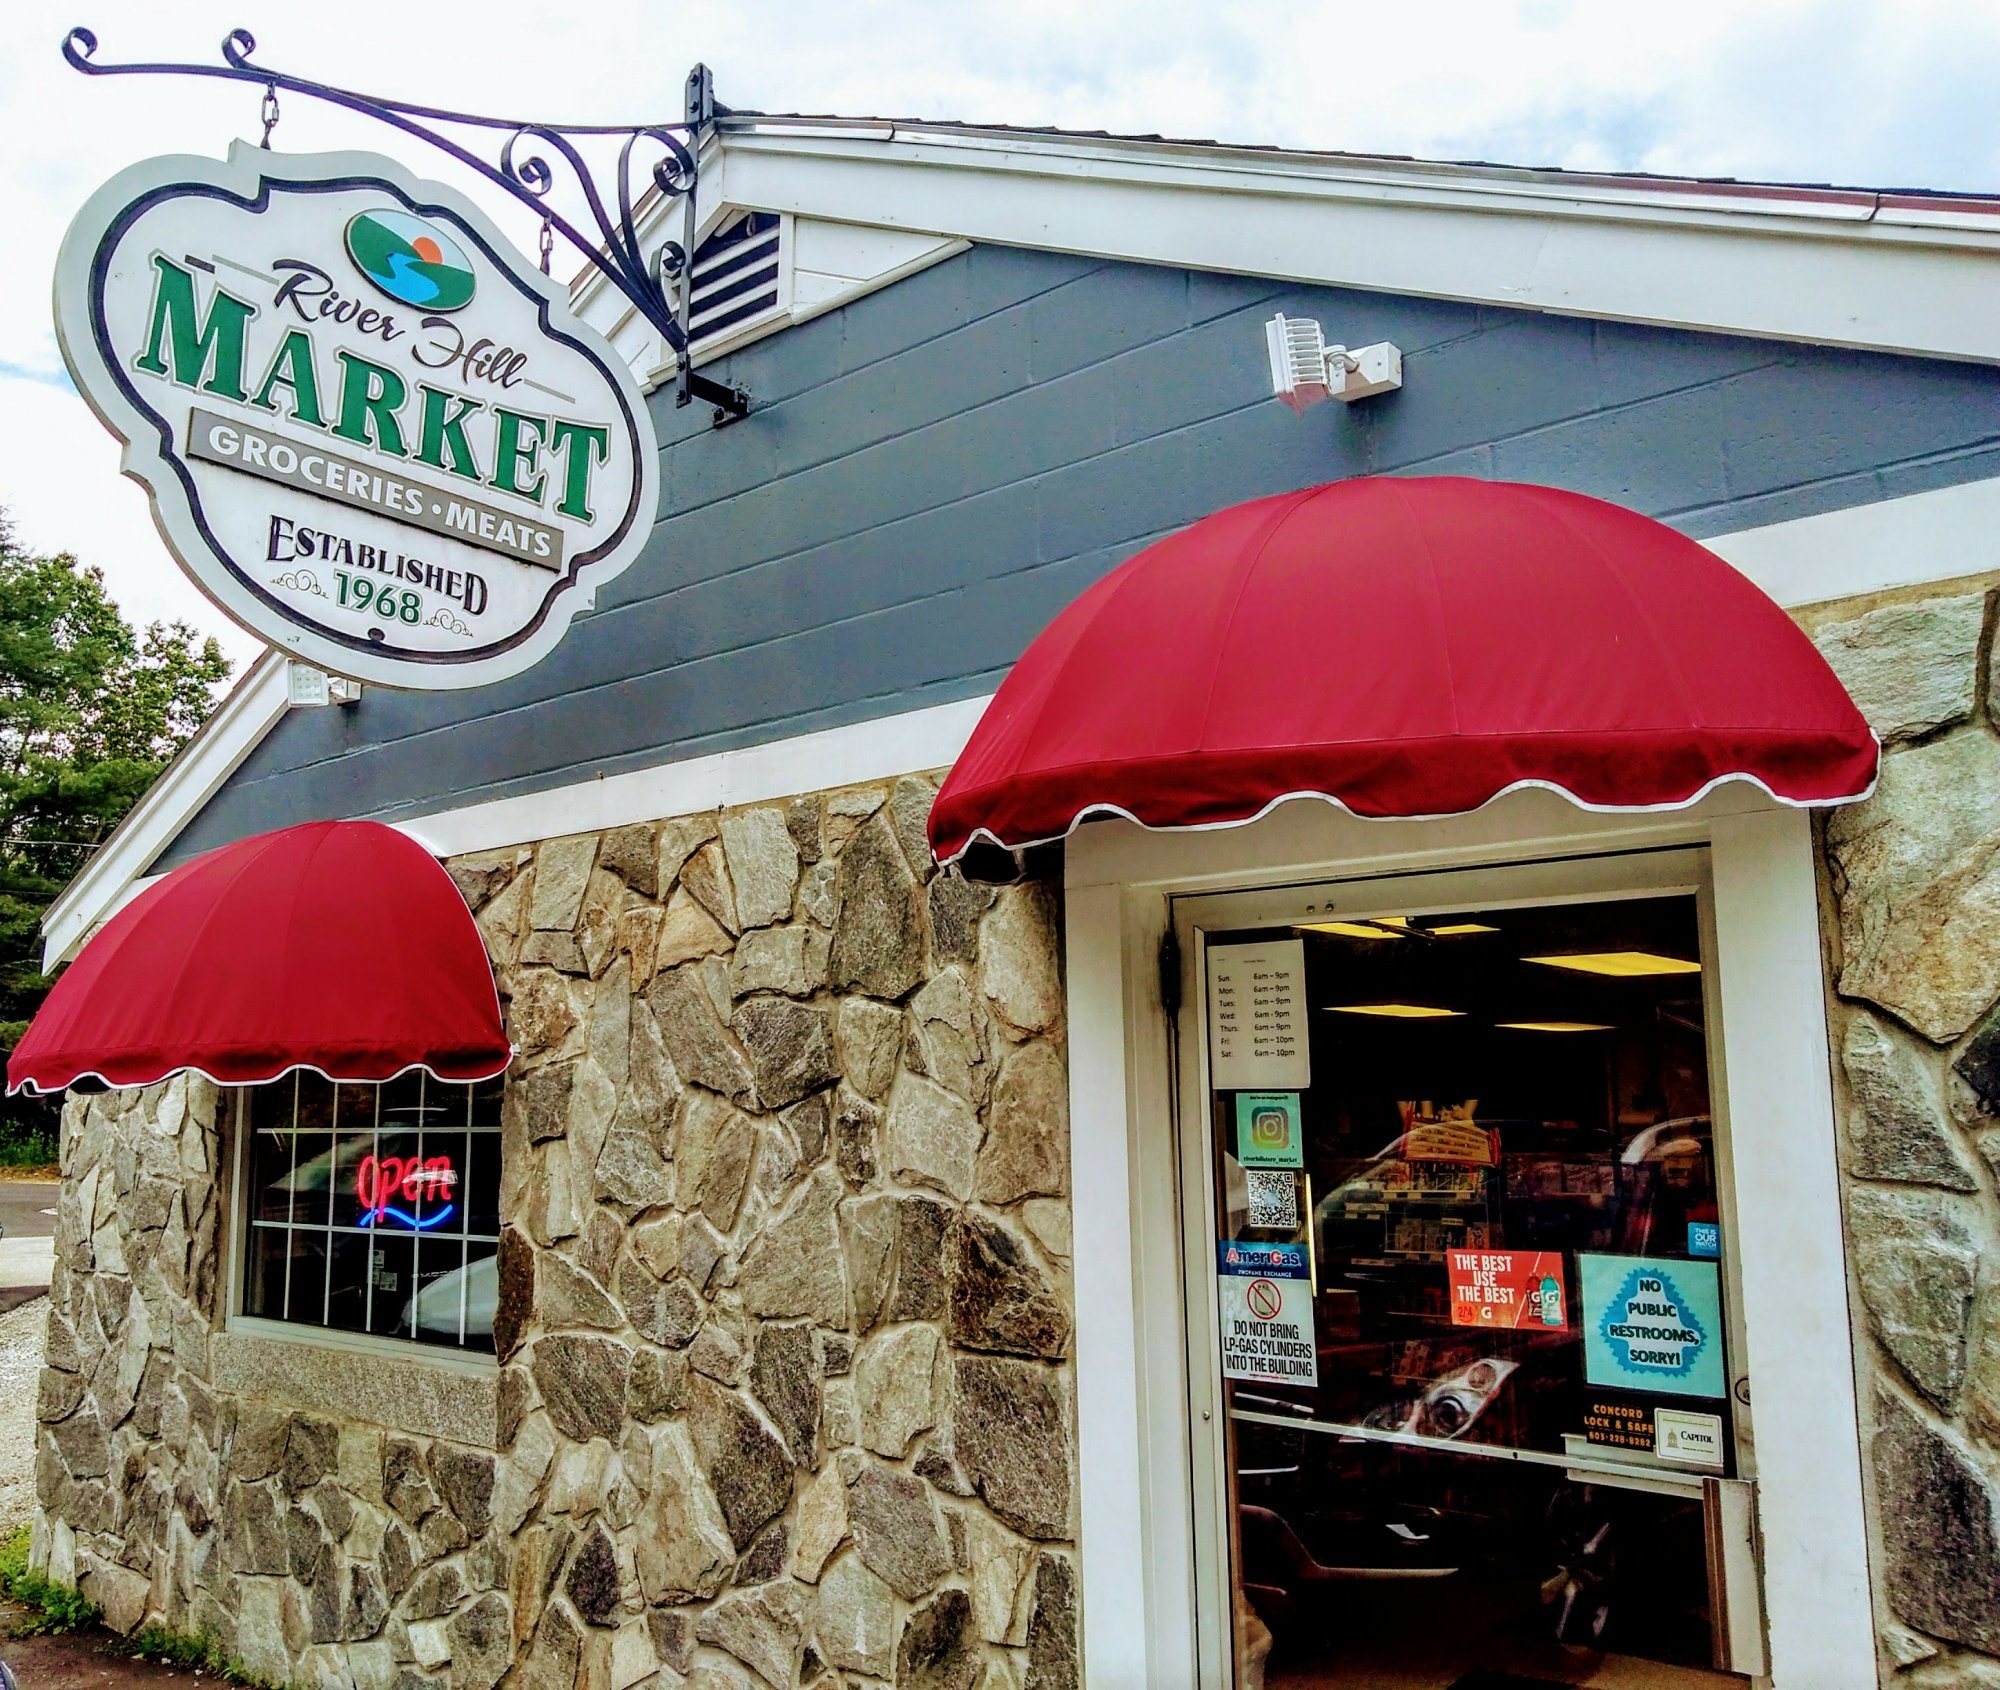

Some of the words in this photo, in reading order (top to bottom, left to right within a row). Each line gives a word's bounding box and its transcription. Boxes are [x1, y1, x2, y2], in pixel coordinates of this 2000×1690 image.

[272, 258, 404, 341] River
[412, 317, 528, 389] Hill
[134, 251, 610, 525] MARKET
[208, 426, 424, 515] GROCERIES
[445, 509, 552, 557] MEATS
[266, 515, 488, 616] ESTABLISHED
[335, 570, 424, 627] 1968
[1254, 972, 1268, 980] 6am
[1275, 971, 1289, 979] 9pm
[1275, 984, 1290, 992] 9pm
[1254, 998, 1268, 1006] 6am
[1275, 997, 1291, 1005] 9pm
[1274, 1010, 1290, 1018] 9pm
[1254, 1023, 1269, 1031] 6am
[1275, 1023, 1291, 1031] 9pm
[1276, 1036, 1294, 1044] 10pm
[1254, 1049, 1269, 1057] 6am
[1276, 1049, 1295, 1057] 10pm
[1694, 1227, 1709, 1235] THIS
[1694, 1233, 1717, 1243] OUR
[1454, 1254, 1479, 1270] THE
[1481, 1255, 1512, 1272] BEST
[1473, 1271, 1498, 1287] USE
[1639, 1279, 1661, 1292] NO
[1457, 1285, 1481, 1303] THE
[1484, 1287, 1515, 1304] BEST
[1481, 1306, 1493, 1319] G
[1627, 1302, 1677, 1317] PUBLIC
[1234, 1320, 1248, 1336] DO
[1249, 1321, 1268, 1337] NOT
[1270, 1323, 1299, 1340] BRING
[1609, 1324, 1700, 1345] RESTROOMS,
[1224, 1336, 1258, 1354] LP-GAS
[1260, 1339, 1313, 1359] CYLINDERS
[1629, 1349, 1681, 1366] SORRY!
[1226, 1354, 1247, 1370] INTO
[1248, 1356, 1267, 1372] THE
[1269, 1358, 1313, 1377] BUILDING
[1593, 1404, 1643, 1419] CONCORD
[1584, 1415, 1610, 1428] LOCK
[1615, 1419, 1622, 1430] &
[1627, 1421, 1655, 1434] SAFE
[1680, 1430, 1714, 1444] CAPITOL
